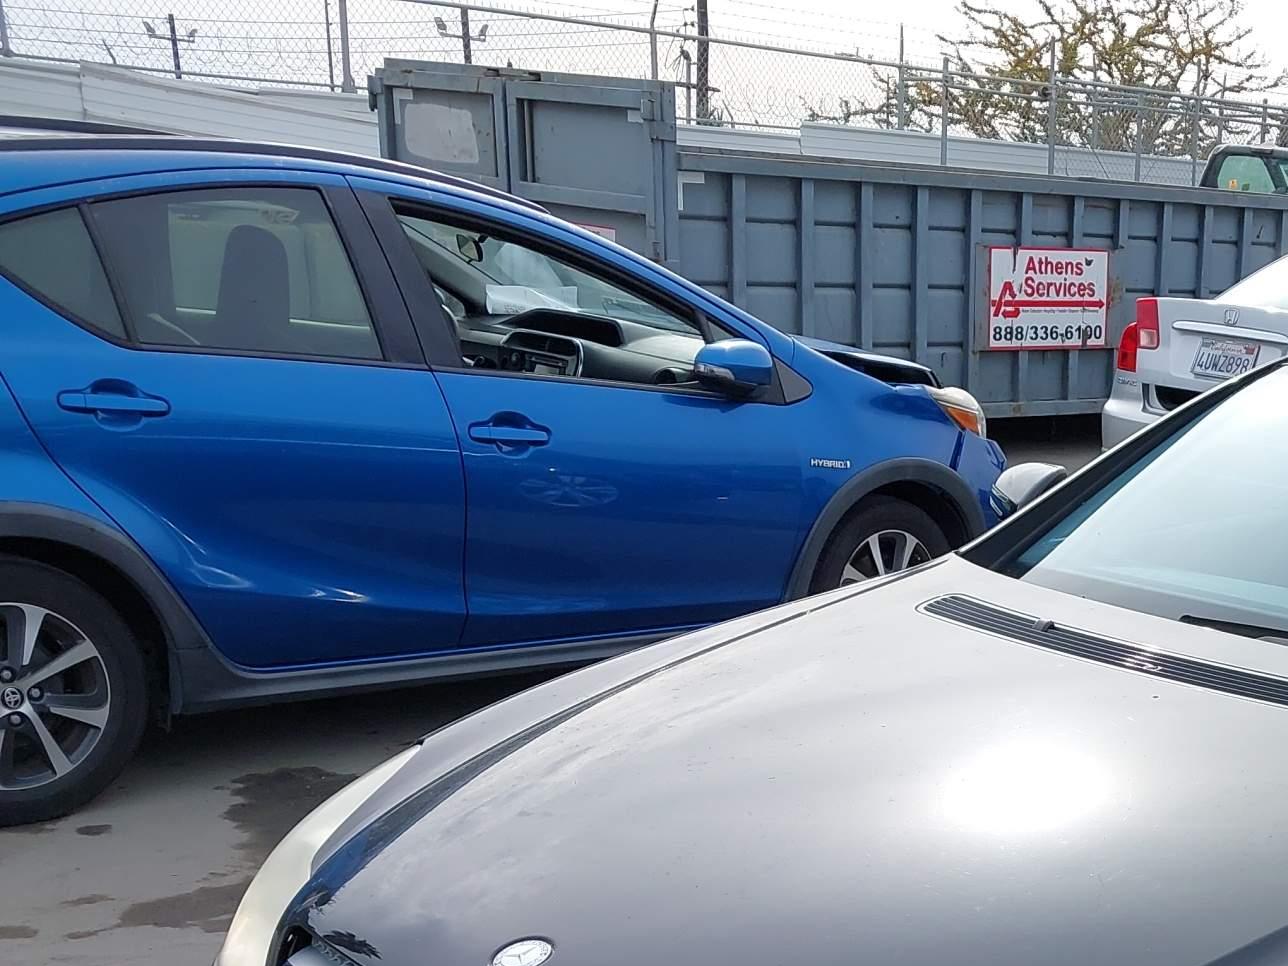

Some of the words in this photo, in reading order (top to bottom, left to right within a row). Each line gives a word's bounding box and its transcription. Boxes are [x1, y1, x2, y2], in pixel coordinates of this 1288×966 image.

[1024, 256, 1084, 276] Athens
[1023, 277, 1096, 297] Services
[1196, 351, 1250, 374] 4UWZ898
[810, 458, 846, 469] HYBRID
